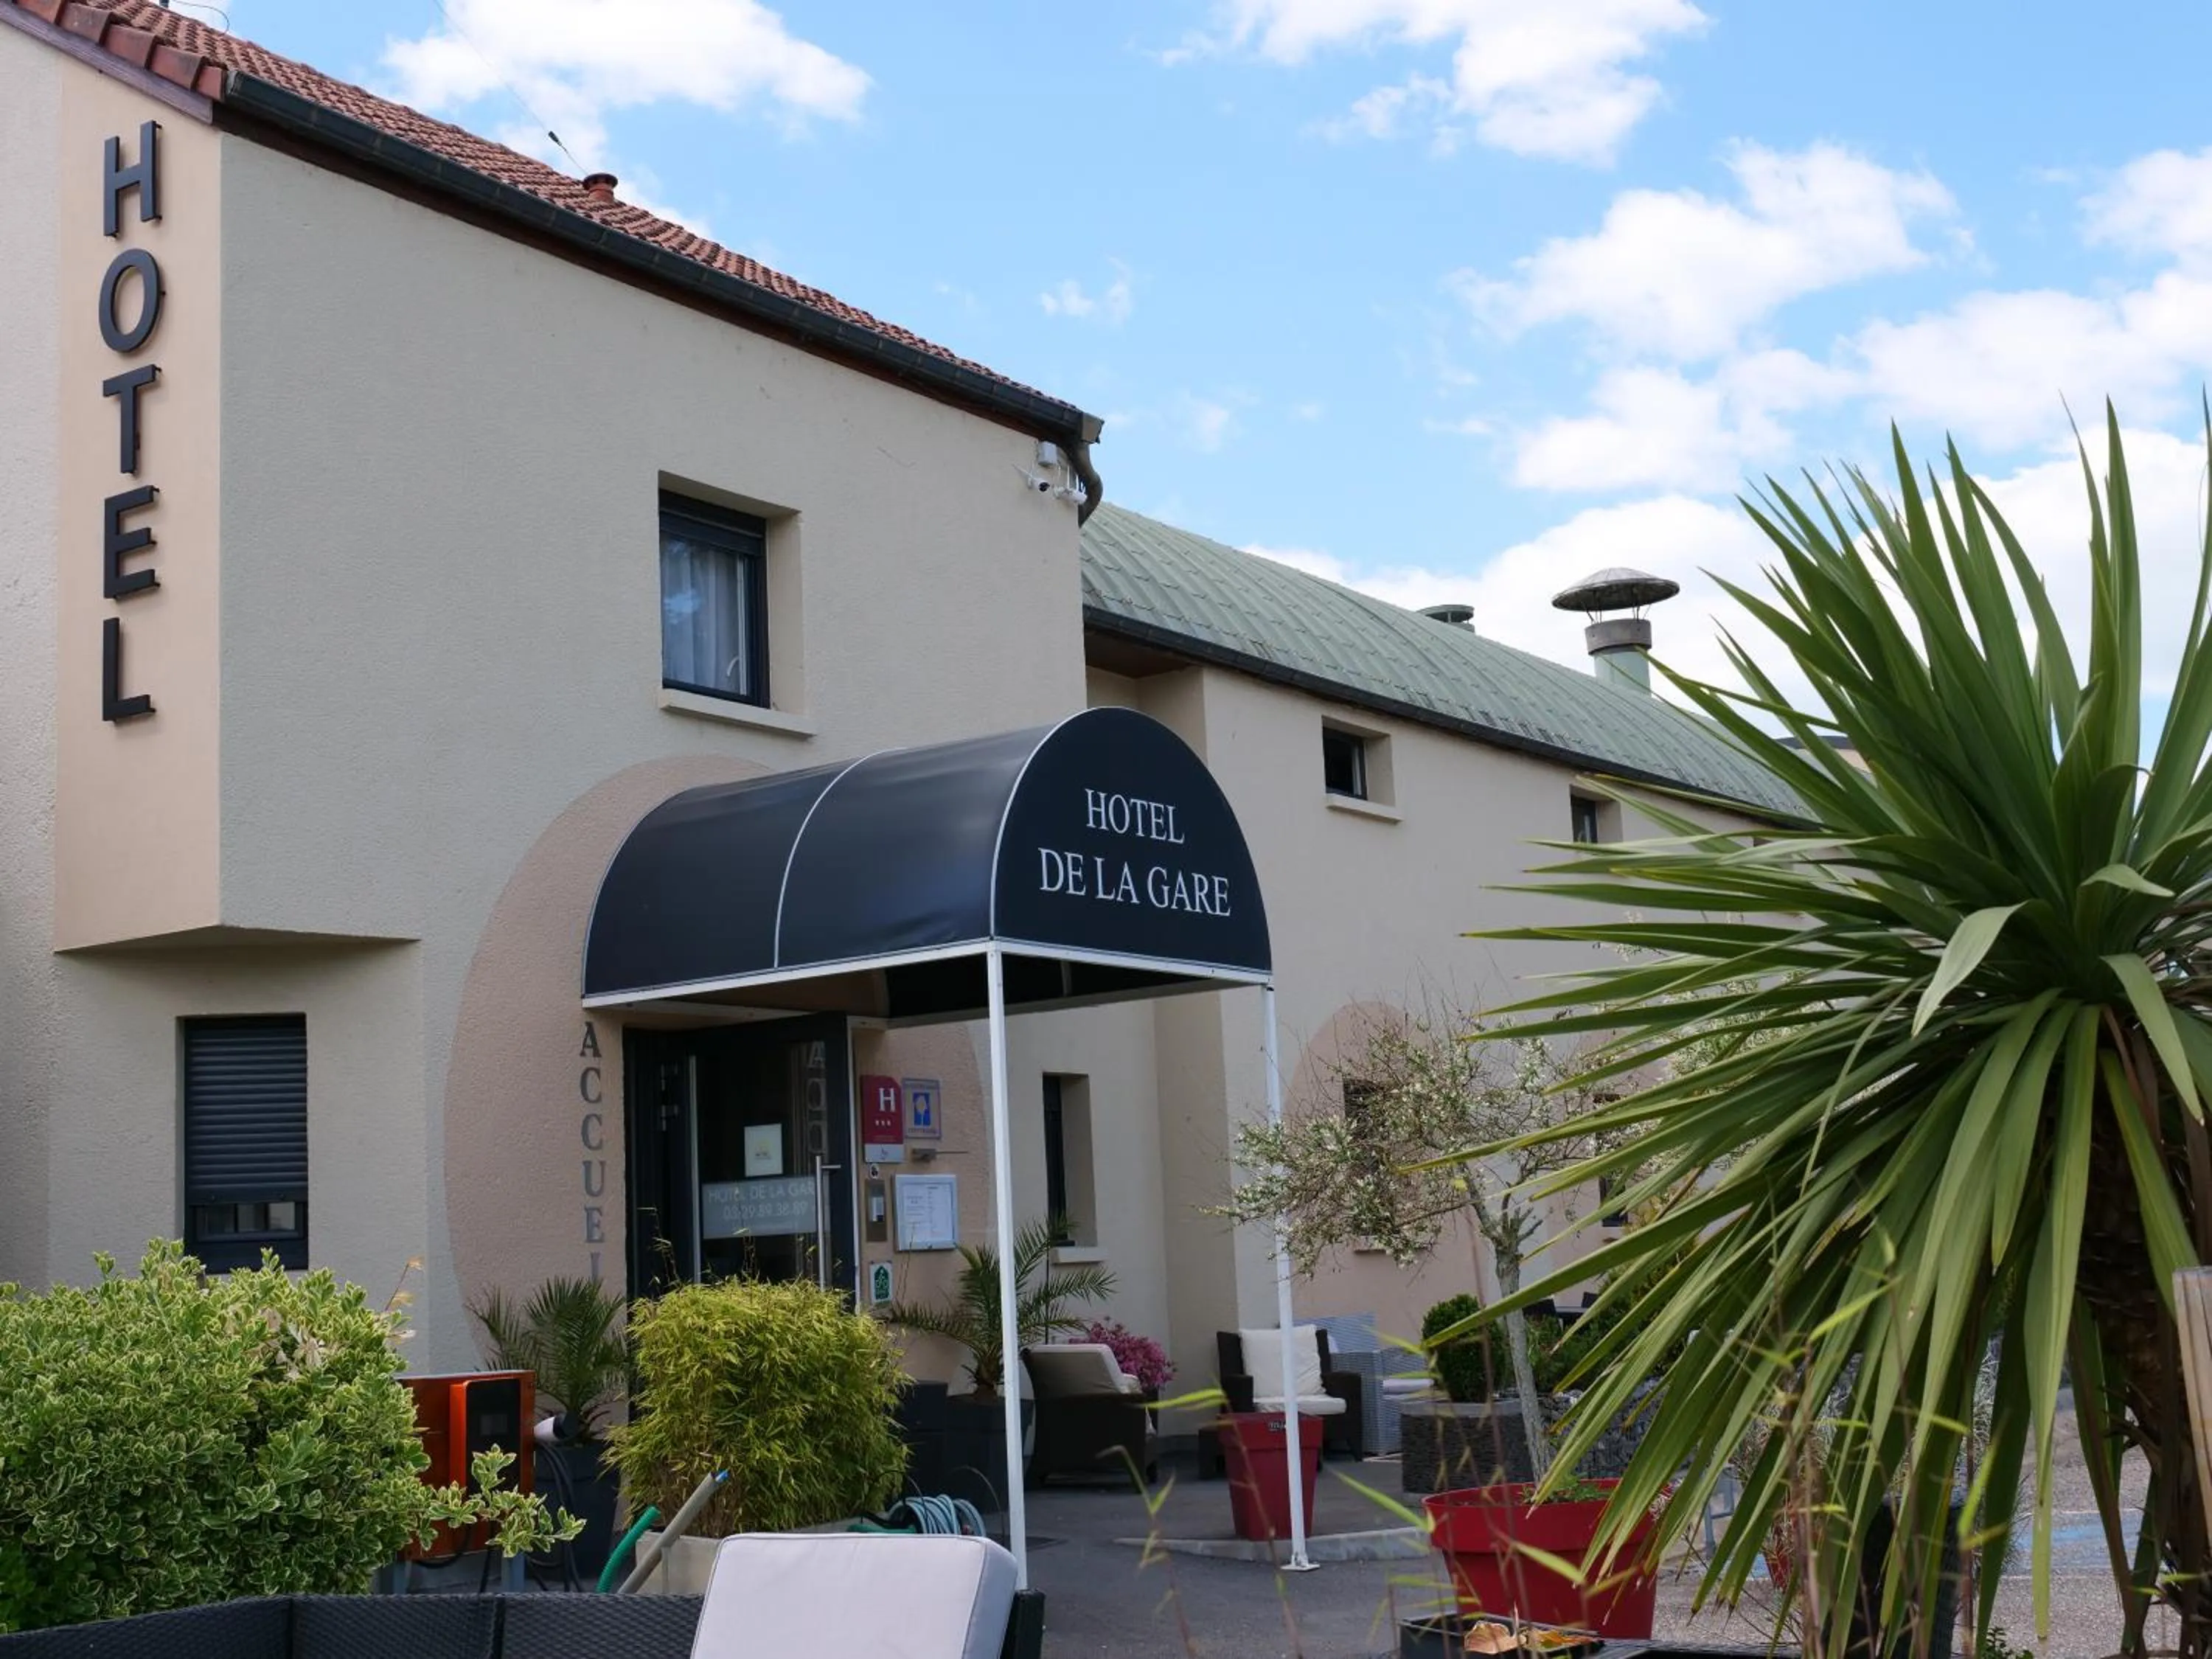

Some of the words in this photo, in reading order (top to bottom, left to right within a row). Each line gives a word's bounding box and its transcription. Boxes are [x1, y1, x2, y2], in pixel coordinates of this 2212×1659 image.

[99, 120, 164, 723] HOTEL
[1085, 787, 1186, 844] HOTEL
[1038, 847, 1086, 897] DE
[1093, 856, 1140, 905] LA
[1147, 866, 1231, 917] GARE
[878, 1087, 896, 1113] H
[579, 1021, 605, 1281] ACCUEI
[708, 1186, 745, 1204] HOTEL
[749, 1184, 767, 1200] DE
[788, 1180, 815, 1197] GAR
